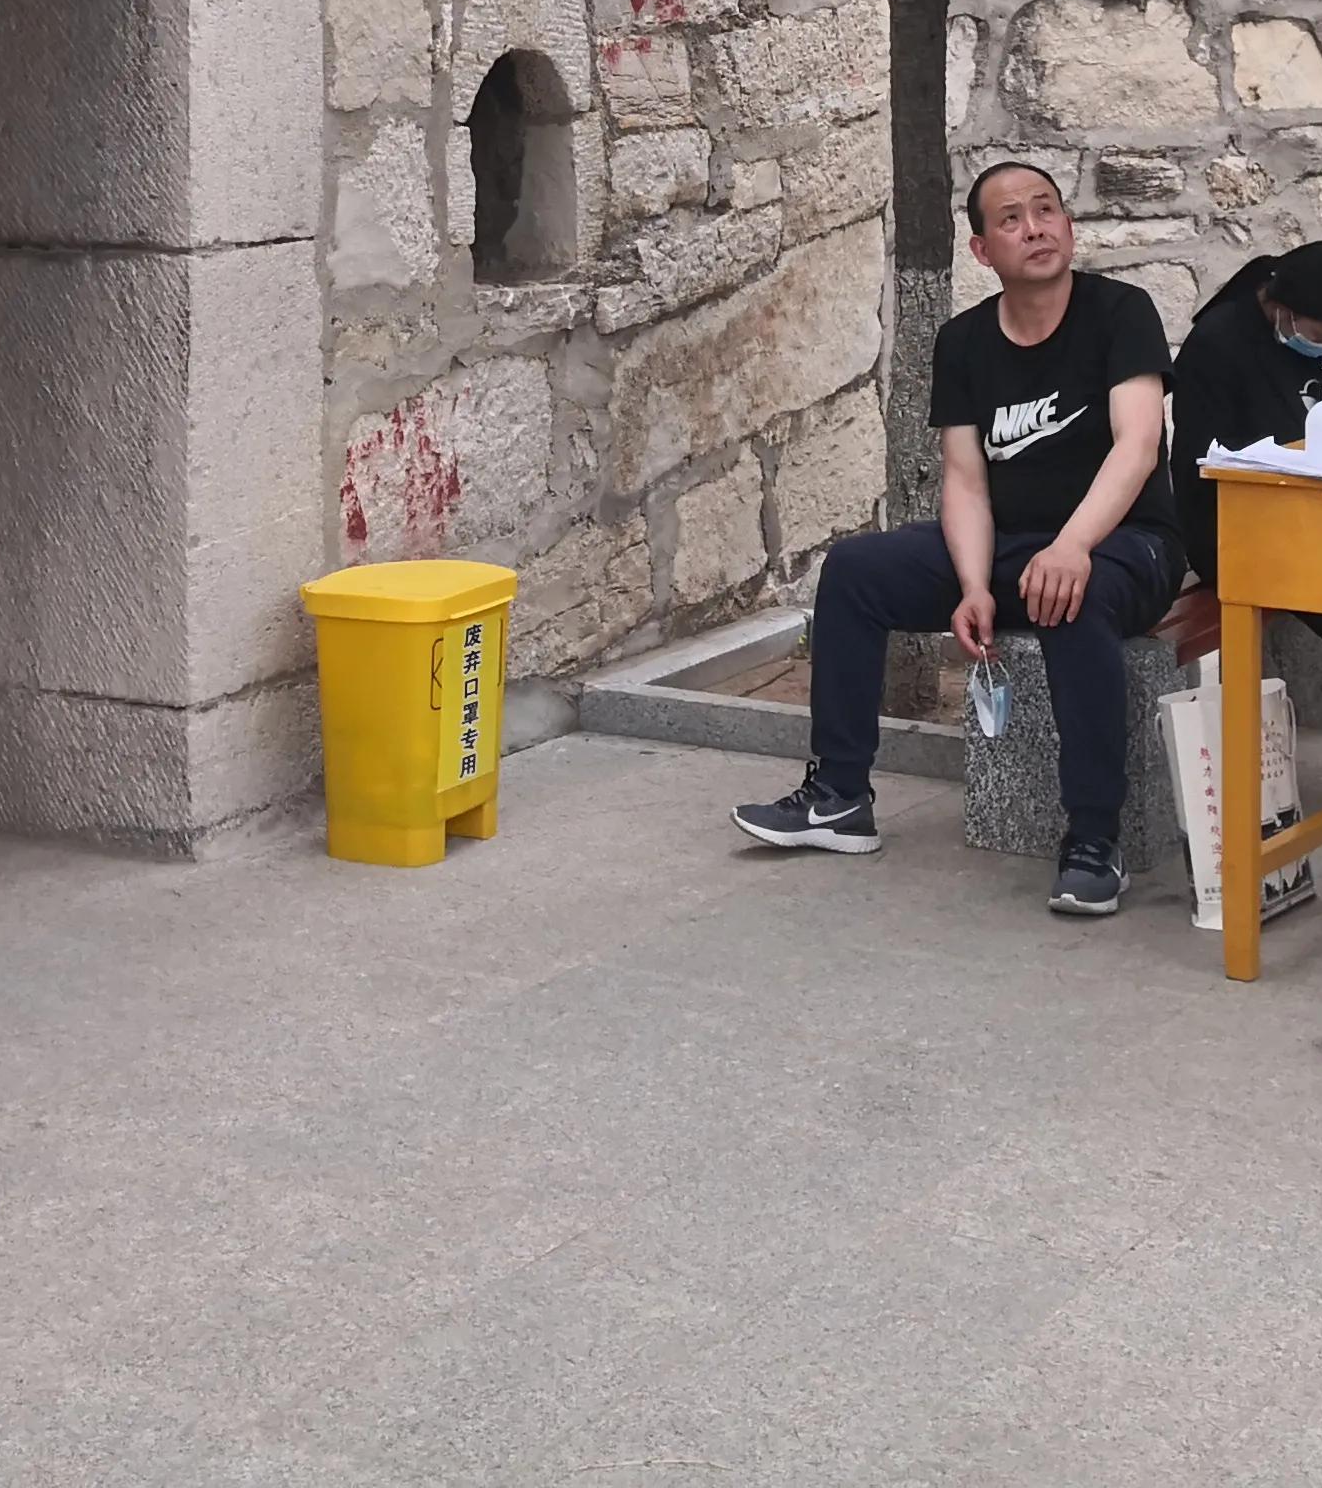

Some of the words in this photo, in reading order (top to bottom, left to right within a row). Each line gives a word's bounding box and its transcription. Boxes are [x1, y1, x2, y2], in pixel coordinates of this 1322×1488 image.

[992, 391, 1059, 443] NIKE
[460, 623, 483, 779] 废弃口罩专用
